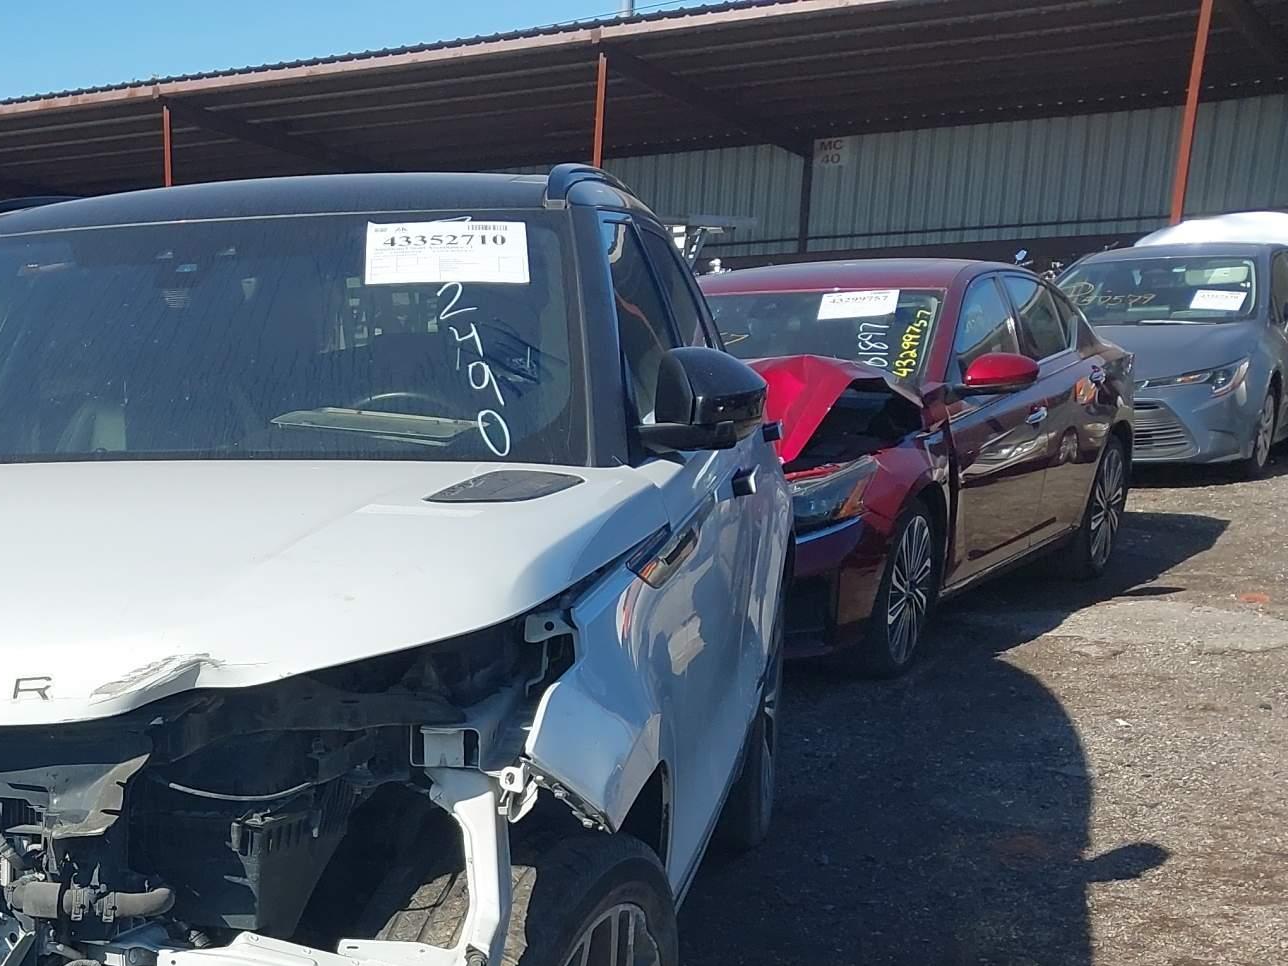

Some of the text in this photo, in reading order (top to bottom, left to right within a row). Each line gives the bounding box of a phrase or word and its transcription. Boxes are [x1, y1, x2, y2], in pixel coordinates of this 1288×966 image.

[819, 139, 843, 151] MC
[383, 233, 507, 247] 43352710
[892, 309, 932, 378] 43299757
